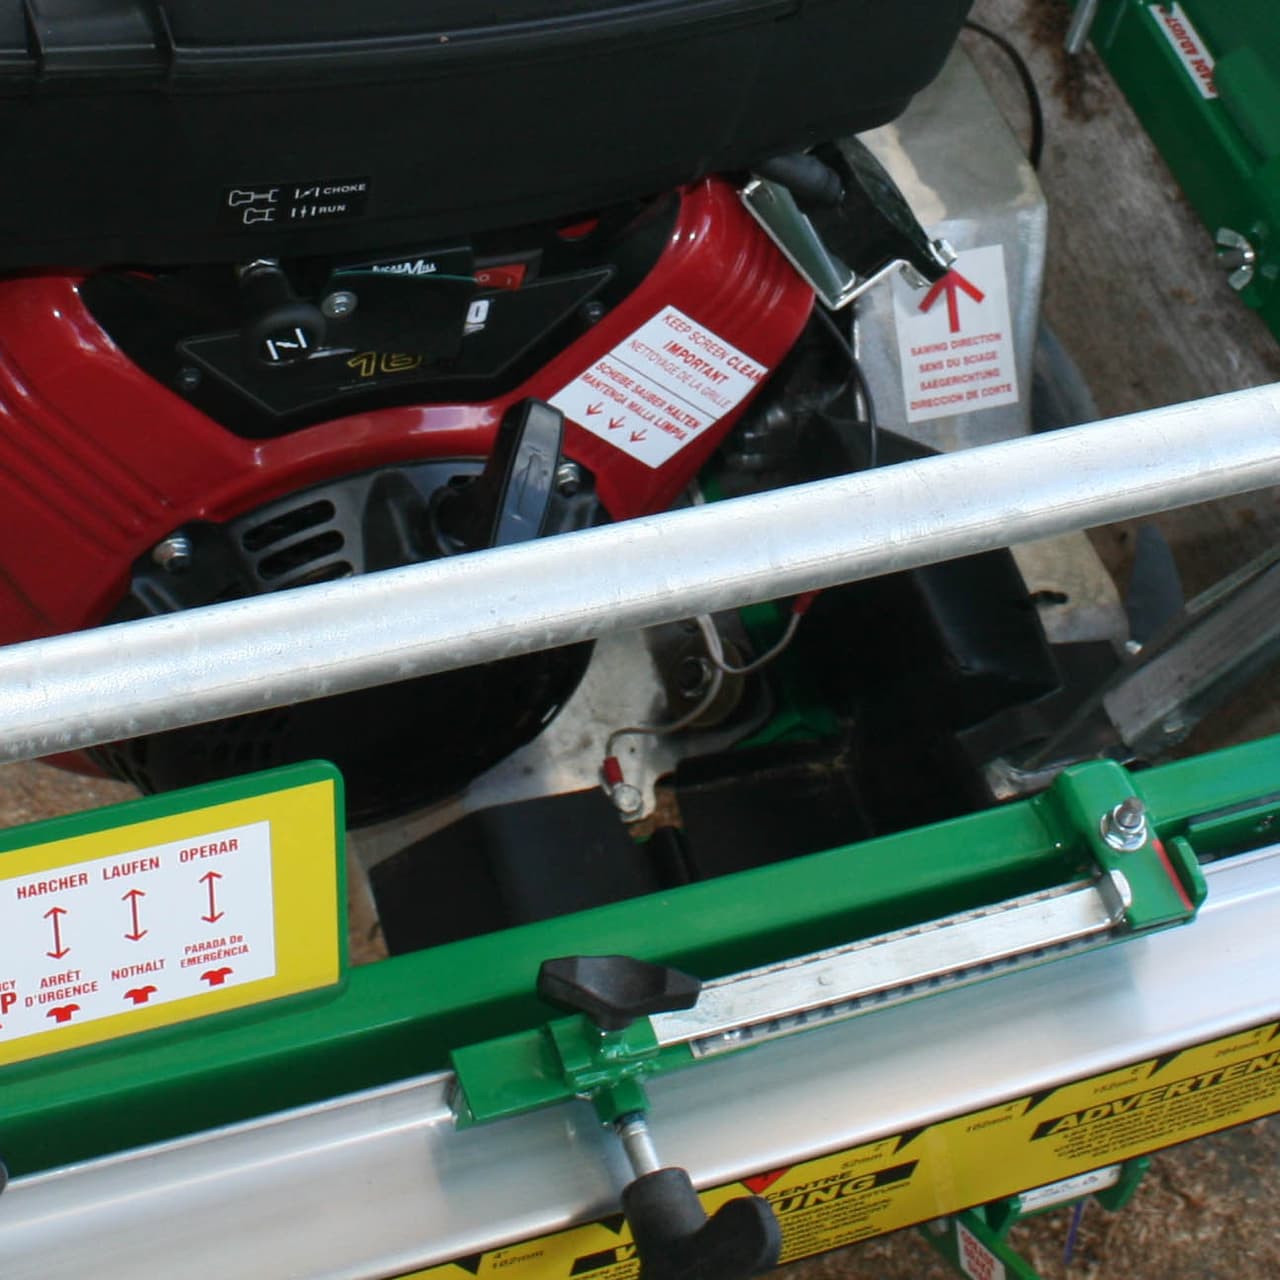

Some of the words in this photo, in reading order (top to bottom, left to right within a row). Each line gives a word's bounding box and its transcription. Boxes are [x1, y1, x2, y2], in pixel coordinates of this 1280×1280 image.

[323, 183, 366, 195] CHOKE
[318, 204, 346, 215] RUN
[662, 313, 692, 334] KEEP
[687, 330, 728, 361] SCREEN
[725, 355, 766, 383] CLEAN
[950, 332, 1002, 350] DIRECTION
[628, 339, 682, 377] NETTOYAGE
[676, 369, 693, 385] DE
[689, 378, 704, 392] LA
[700, 384, 733, 409] GRILLE
[663, 340, 730, 384] IMPORTANT
[919, 361, 945, 374] SENS
[946, 358, 961, 369] DU
[963, 350, 998, 366] SCIAGE
[920, 368, 1001, 391] SAEGERICHTUNG
[966, 390, 980, 401] DE
[981, 383, 1012, 397] CORTE
[624, 399, 659, 423] MALLA
[653, 417, 688, 441] LIMPIA
[666, 403, 702, 429] HALTEN
[179, 838, 239, 864] OPERAR
[102, 856, 160, 881] LAUFEN
[17, 872, 89, 900] HARCHER
[184, 937, 227, 955] PARADA
[40, 969, 82, 990] ARRÊT
[111, 958, 166, 981] NOTHALT
[24, 980, 99, 1008] D'URGENCE
